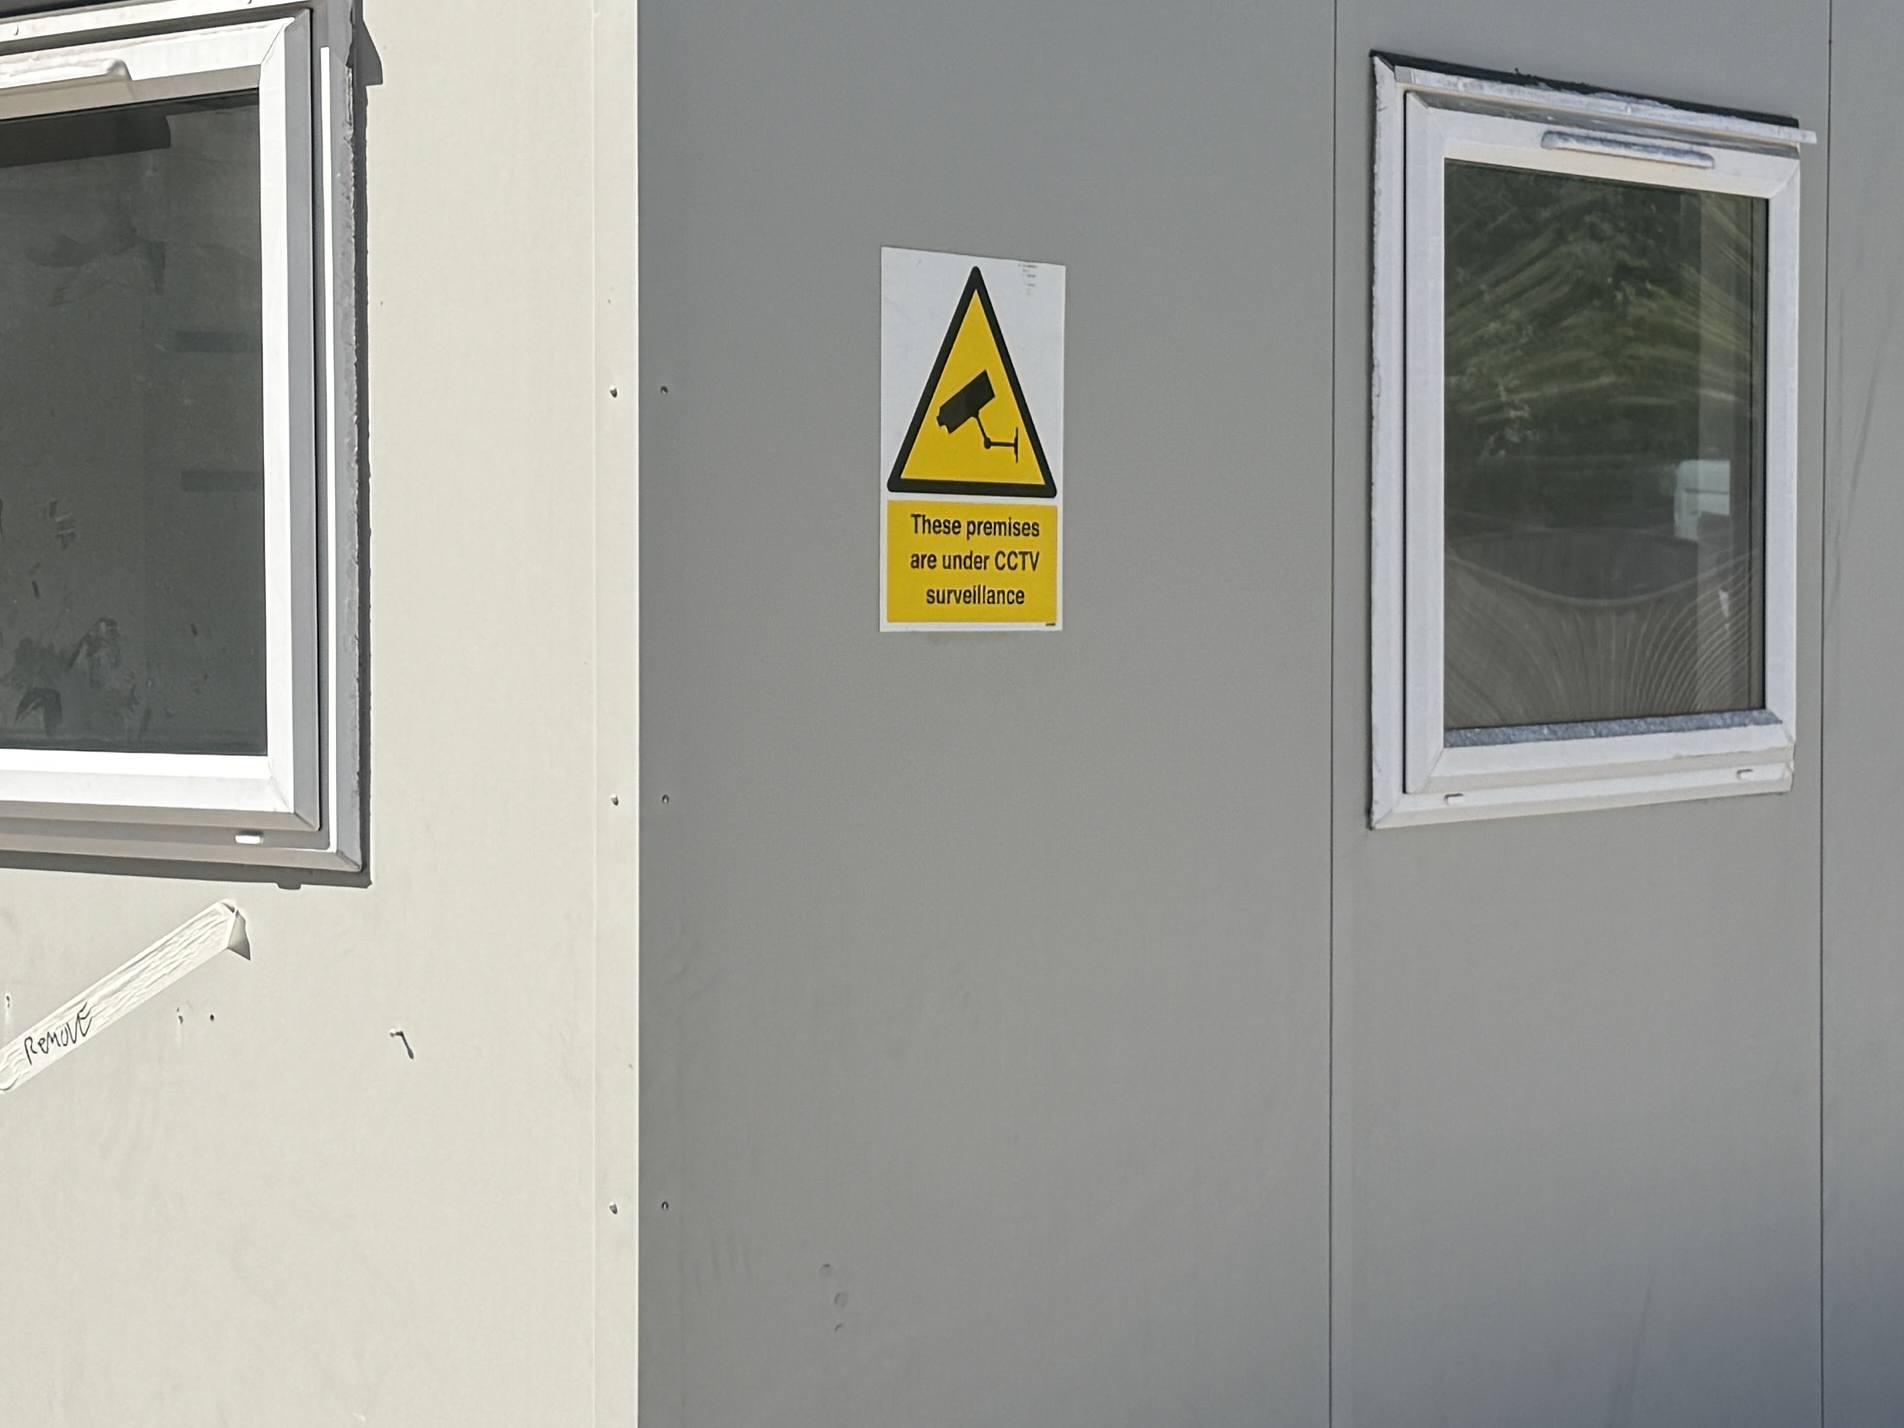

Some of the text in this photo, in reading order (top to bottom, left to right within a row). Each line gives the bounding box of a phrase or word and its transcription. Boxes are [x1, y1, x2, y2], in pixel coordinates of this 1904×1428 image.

[910, 513, 1040, 540] These premises
[910, 550, 1040, 571] are under CCTV
[926, 584, 1025, 605] surveillance
